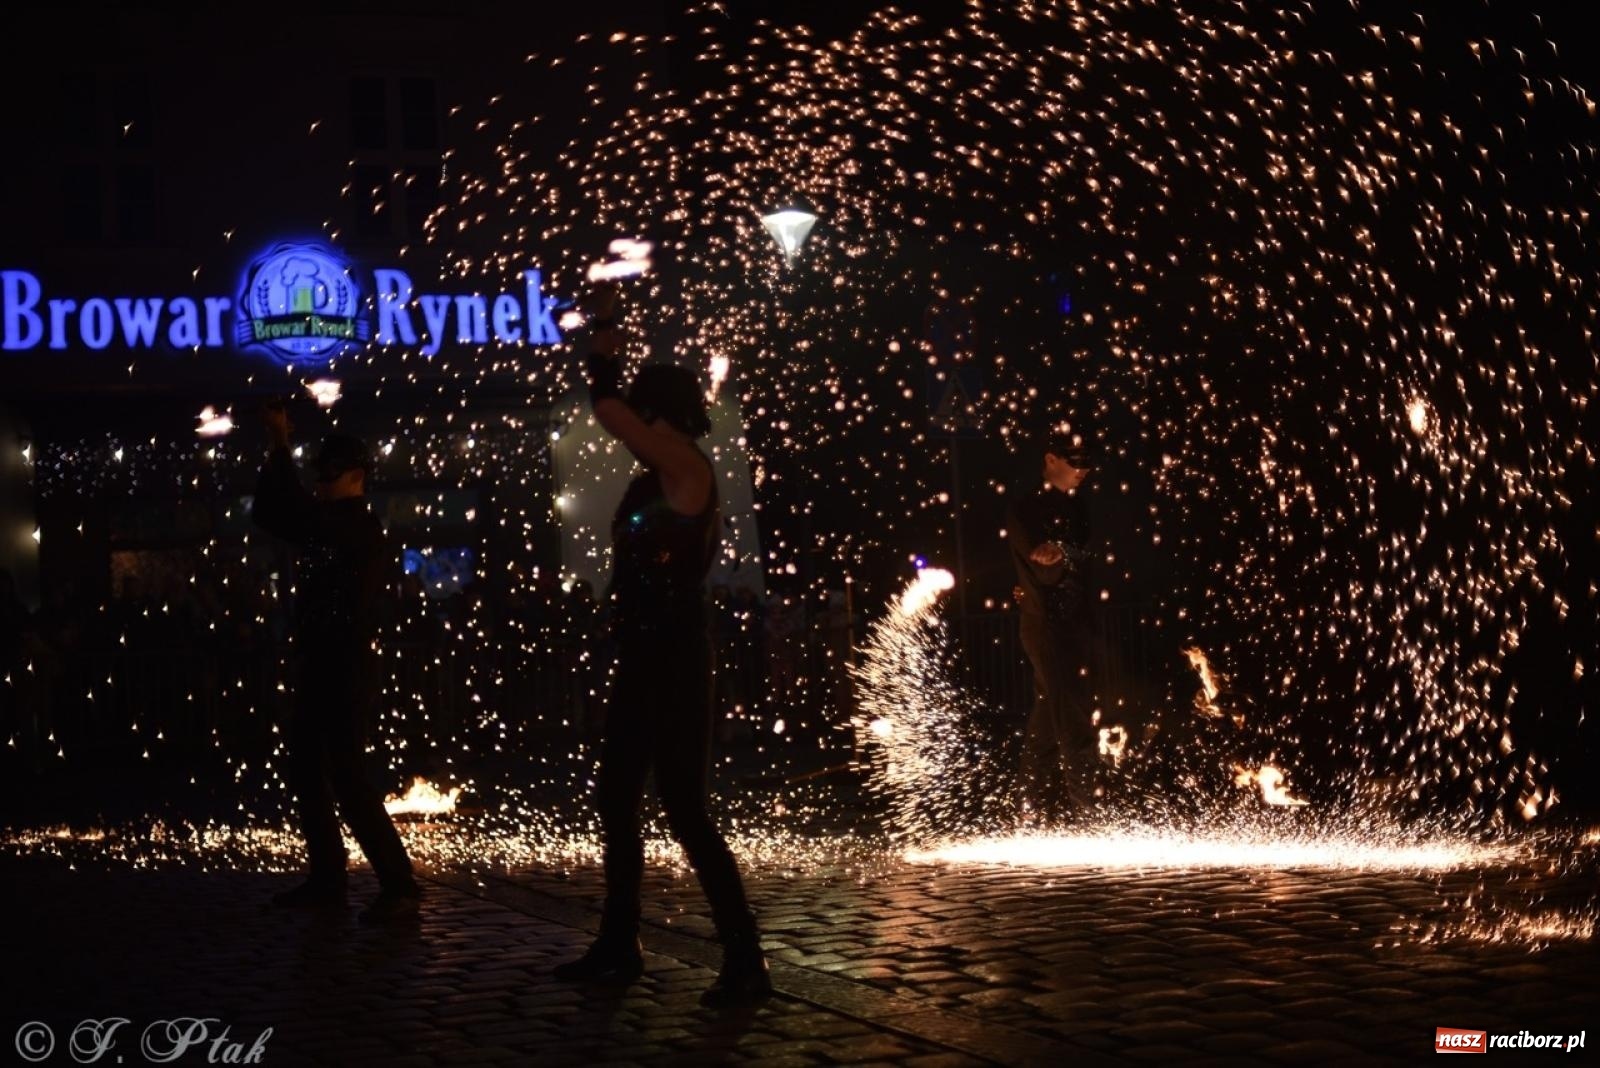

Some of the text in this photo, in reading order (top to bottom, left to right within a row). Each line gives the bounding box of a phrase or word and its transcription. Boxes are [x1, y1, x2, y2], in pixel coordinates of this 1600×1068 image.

[1, 268, 561, 356] Browar Rynek
[254, 315, 354, 339] Browar Rynek
